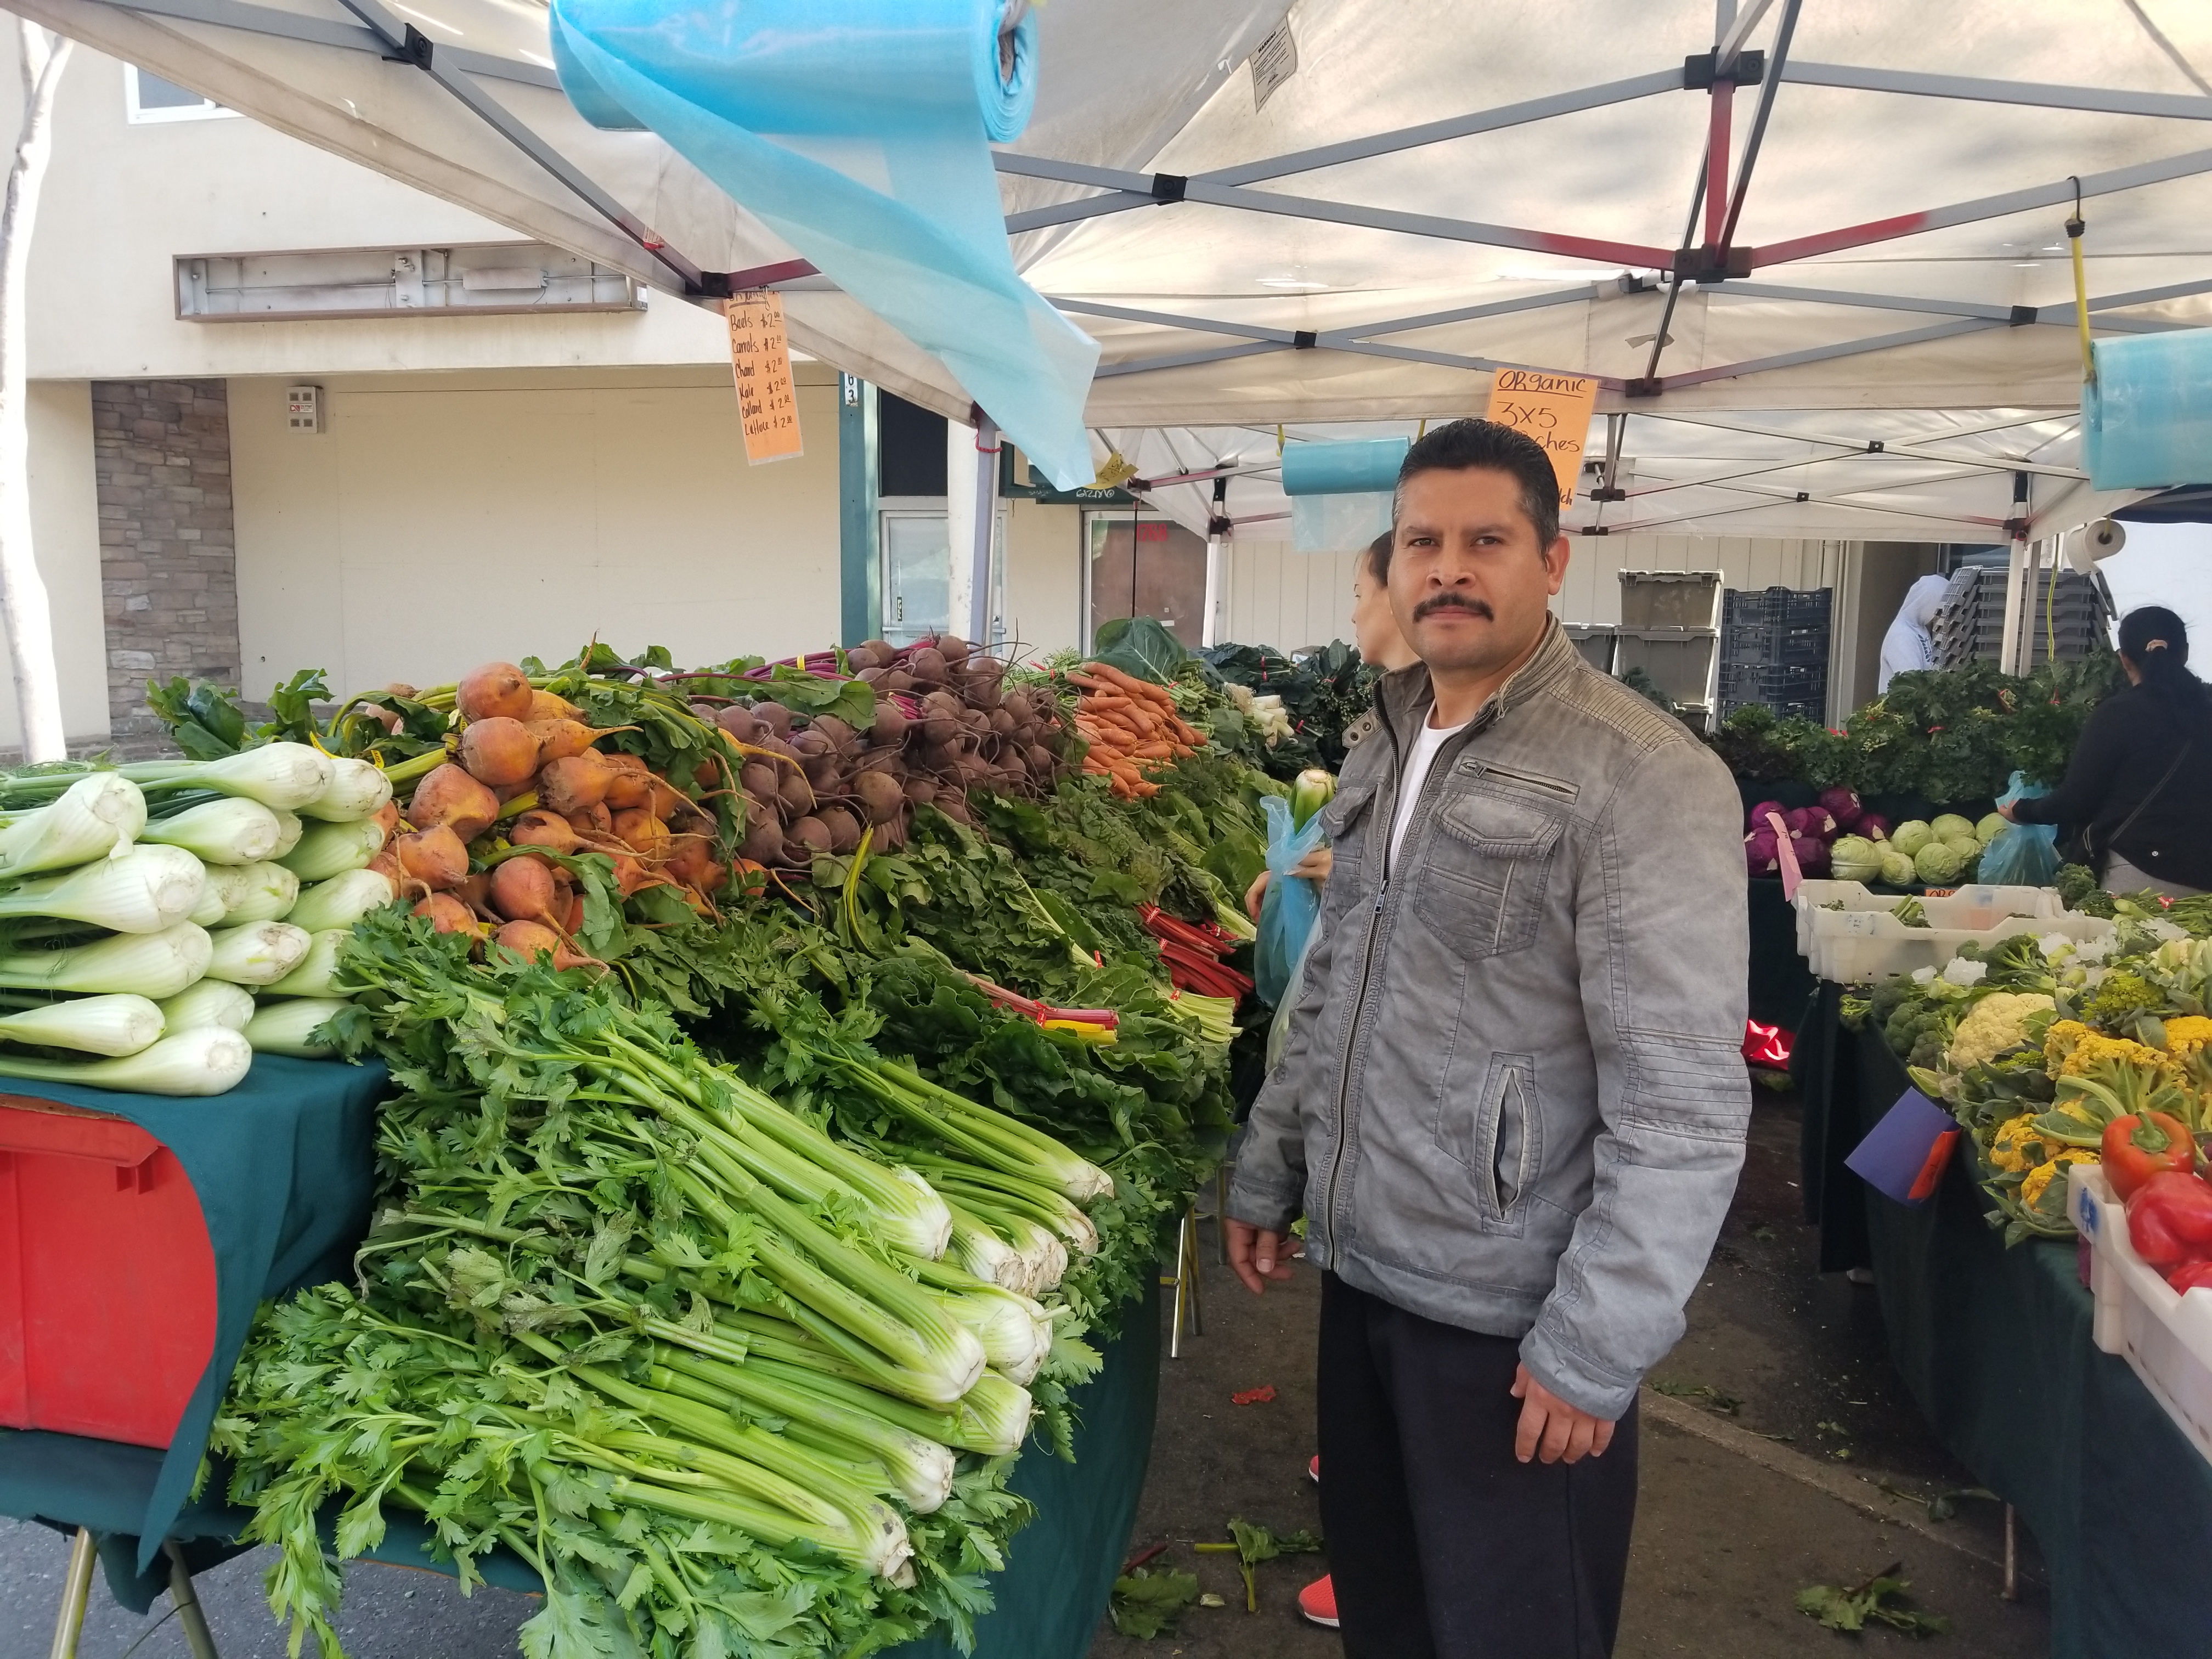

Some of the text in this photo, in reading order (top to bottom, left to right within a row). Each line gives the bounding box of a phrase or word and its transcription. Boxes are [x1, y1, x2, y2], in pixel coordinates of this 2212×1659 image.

[1258, 31, 1276, 53] WARNING
[730, 311, 753, 331] Beets
[732, 333, 759, 353] Carrots
[736, 359, 755, 378] Chard
[739, 383, 754, 400] Kale
[742, 399, 762, 419] Collard
